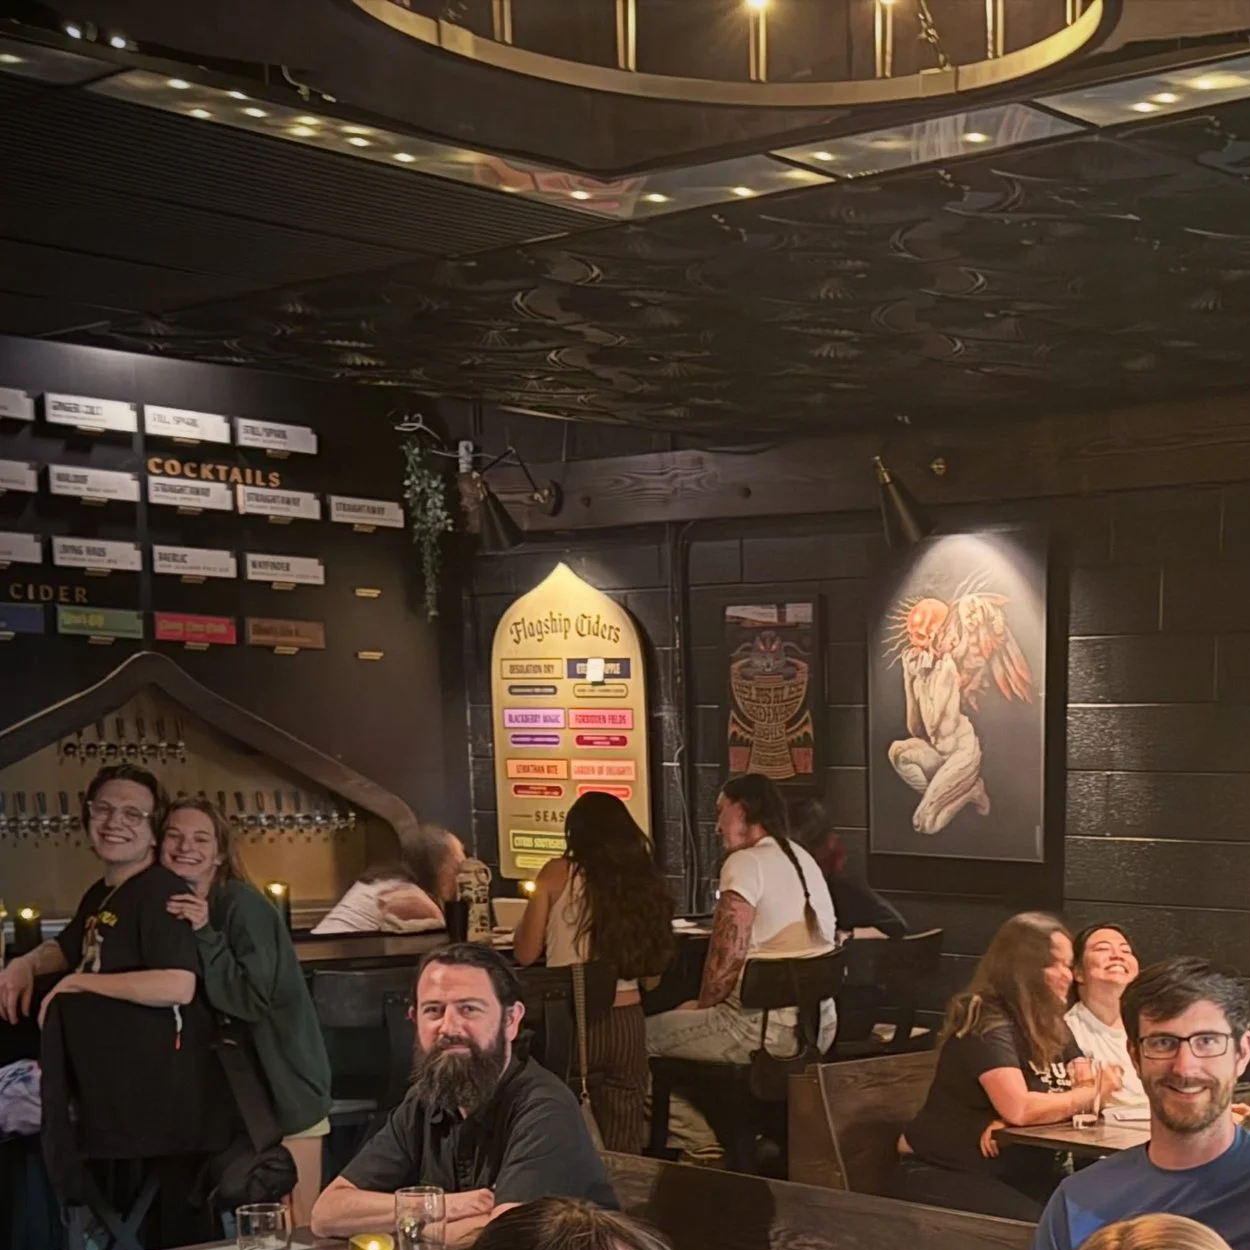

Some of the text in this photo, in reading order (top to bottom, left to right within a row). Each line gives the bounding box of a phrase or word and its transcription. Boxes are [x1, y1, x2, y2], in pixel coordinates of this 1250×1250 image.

[147, 456, 281, 488] COCKTAILS
[9, 582, 88, 603] CIDER
[509, 611, 621, 645] Flagship Ciders
[534, 810, 565, 822] SEAS
